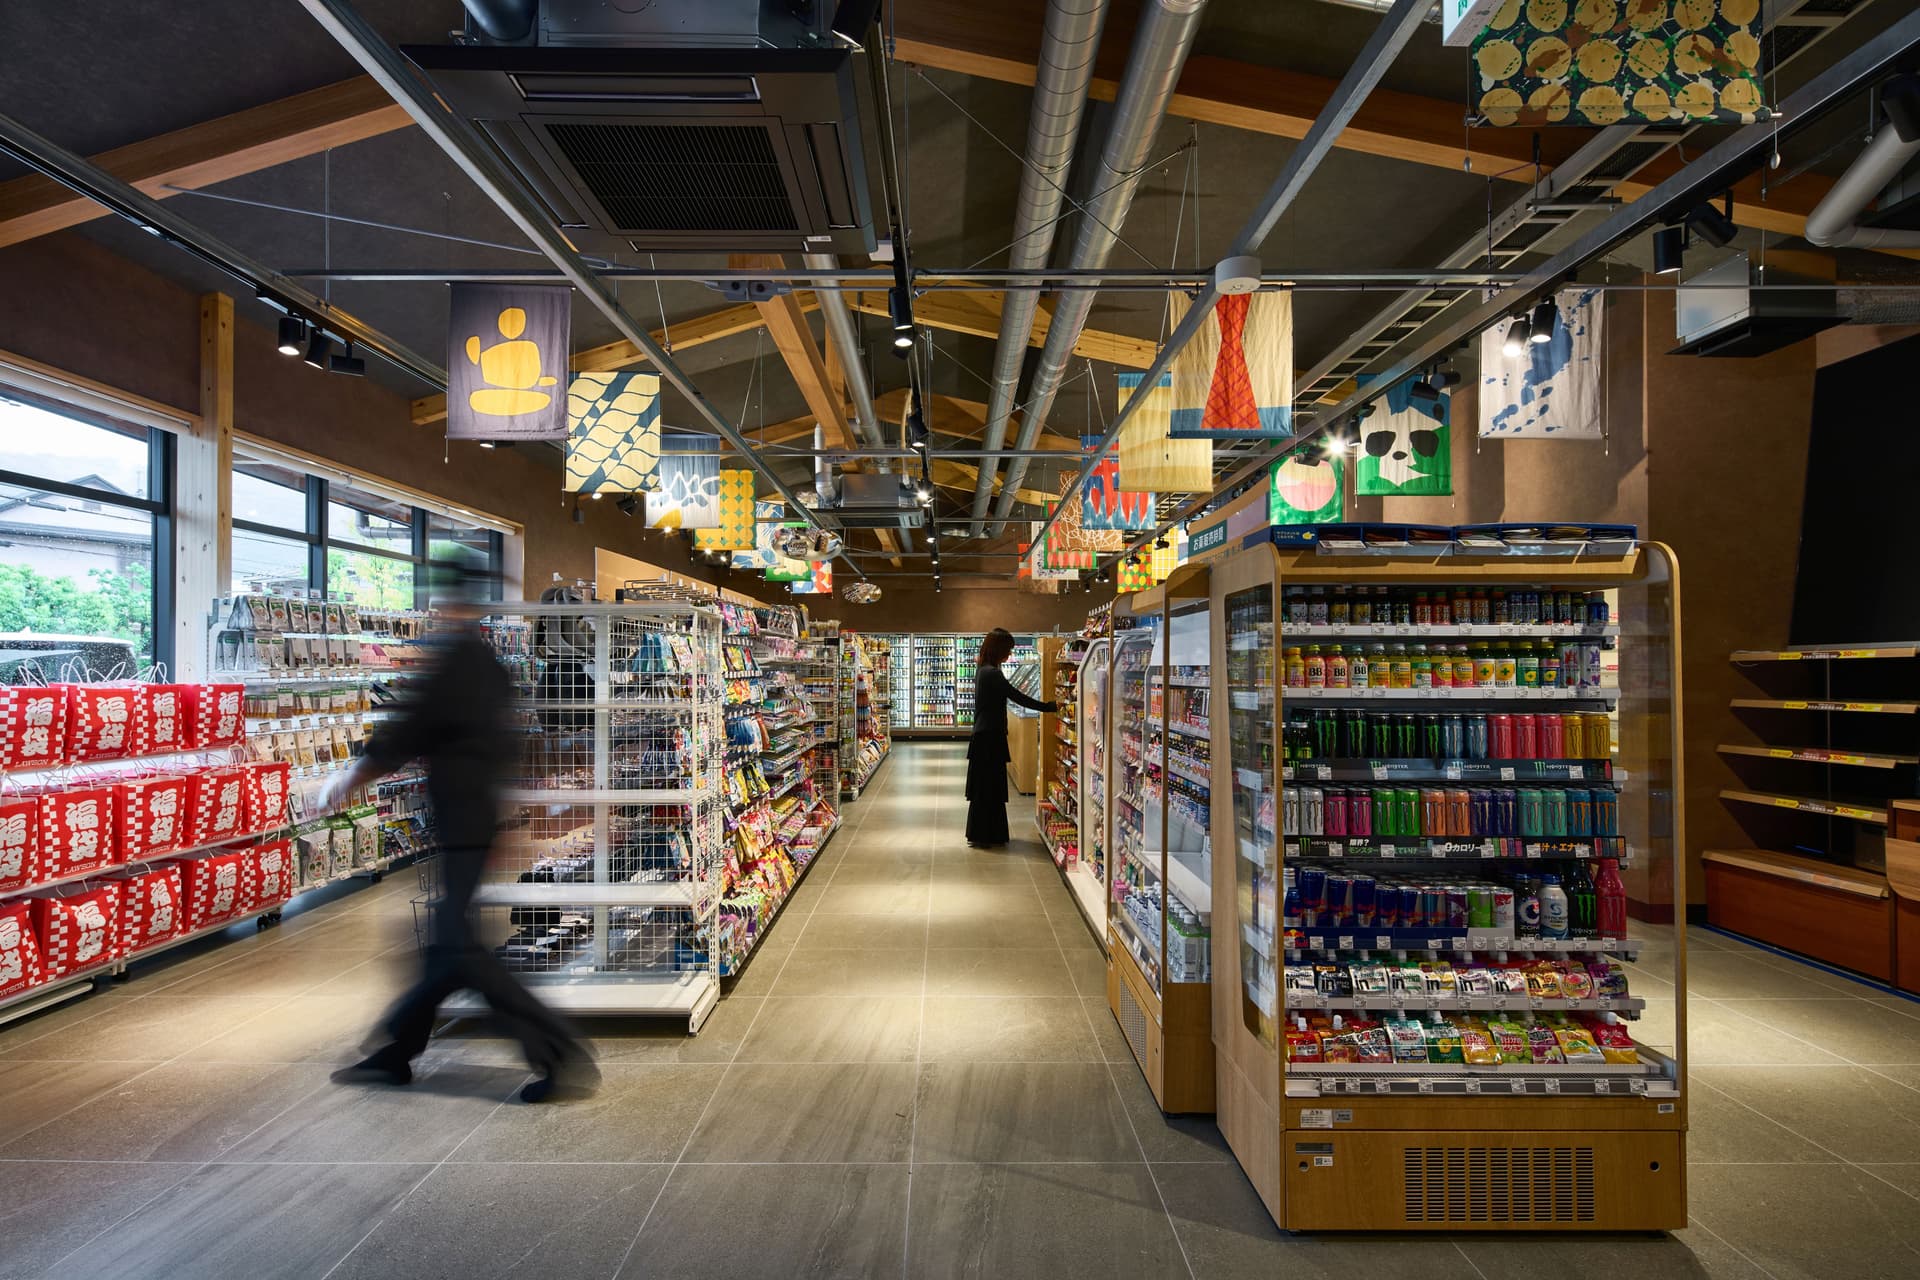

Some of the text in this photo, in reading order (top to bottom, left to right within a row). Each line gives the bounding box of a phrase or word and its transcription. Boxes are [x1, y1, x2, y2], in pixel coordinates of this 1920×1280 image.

[1309, 667, 1322, 676] BB
[1334, 668, 1346, 677] BB
[1354, 666, 1367, 675] BB
[21, 697, 54, 757] 福袋
[96, 696, 128, 750] 福袋
[153, 692, 175, 743] 福袋
[215, 691, 240, 738] 福袋
[214, 780, 240, 832] 福袋
[260, 770, 282, 818] 福袋
[65, 799, 98, 861] 福袋
[149, 788, 177, 845] 福袋
[64, 861, 97, 875] LAWSON
[260, 848, 282, 898] 福袋
[210, 862, 237, 915] 福袋
[148, 878, 173, 935] 福袋
[75, 900, 106, 962] 福袋
[1286, 973, 1299, 989] in
[1321, 974, 1335, 993] in
[1355, 975, 1370, 990] in
[1392, 975, 1405, 989] in
[1426, 975, 1440, 990] in
[1459, 976, 1474, 992] in
[1495, 978, 1510, 992] in
[1527, 974, 1541, 989] in
